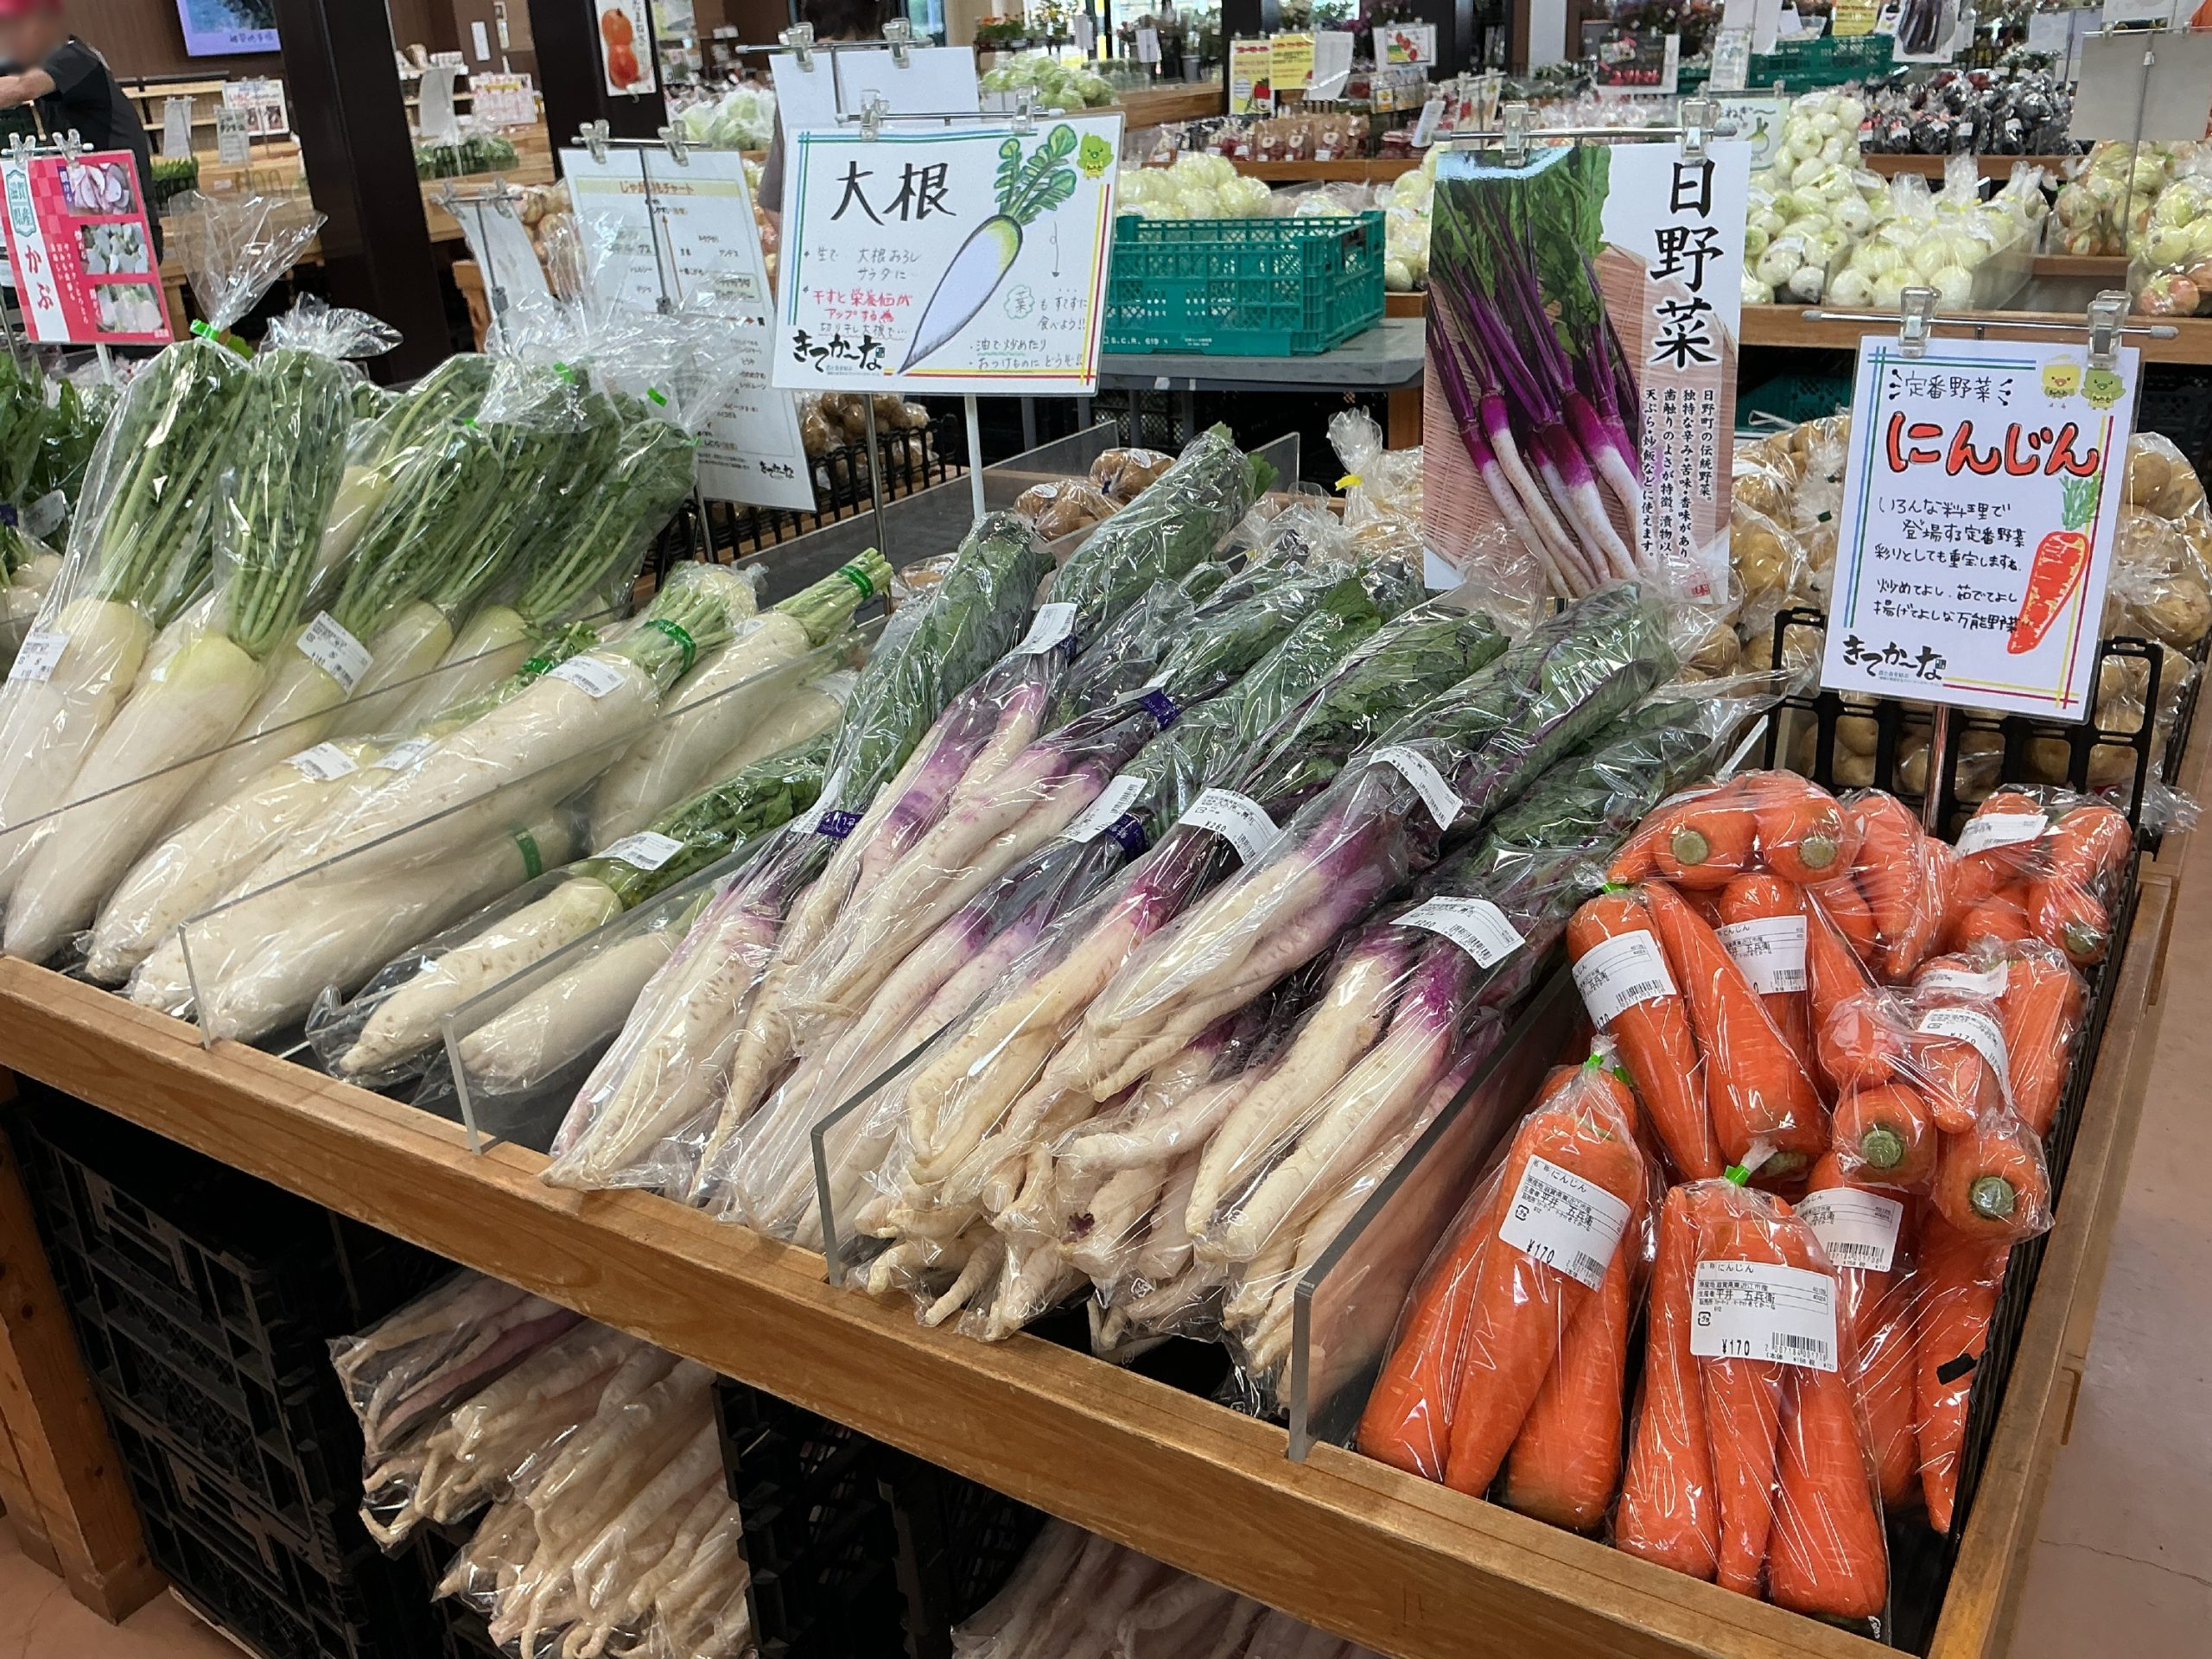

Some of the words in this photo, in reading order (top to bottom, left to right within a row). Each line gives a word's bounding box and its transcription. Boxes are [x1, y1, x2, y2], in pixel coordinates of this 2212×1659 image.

[830, 162, 957, 226] 大根
[857, 249, 920, 263] 大根おろし
[1649, 159, 1724, 368] 日野菜
[25, 245, 54, 310] かぶ
[857, 268, 906, 281] サラダに
[813, 289, 912, 306] 干すと栄養価が
[1015, 291, 1027, 313] 葉
[824, 309, 877, 321] アップする
[1905, 371, 1993, 403] 定番野菜
[1699, 389, 1715, 502] 日野町の伝統野菜。
[1886, 411, 2101, 477] にんじん
[1642, 389, 1657, 557] 天ぷら・炒飯などに使えます。
[1659, 389, 1676, 557] 歯触りのよさが特徴。漬物以
[1878, 496, 2012, 519] いろんな料理で
[1903, 519, 2025, 548] 登場する定番野菜
[1205, 821, 1227, 831] ¥260
[1551, 1170, 1586, 1192] にんじん
[1527, 1239, 1554, 1263] ¥170
[1718, 1264, 1754, 1274] にんじん
[1716, 1289, 1733, 1300] 平井
[1744, 1290, 1776, 1304] 五兵衛
[1722, 1339, 1751, 1356] ¥170
